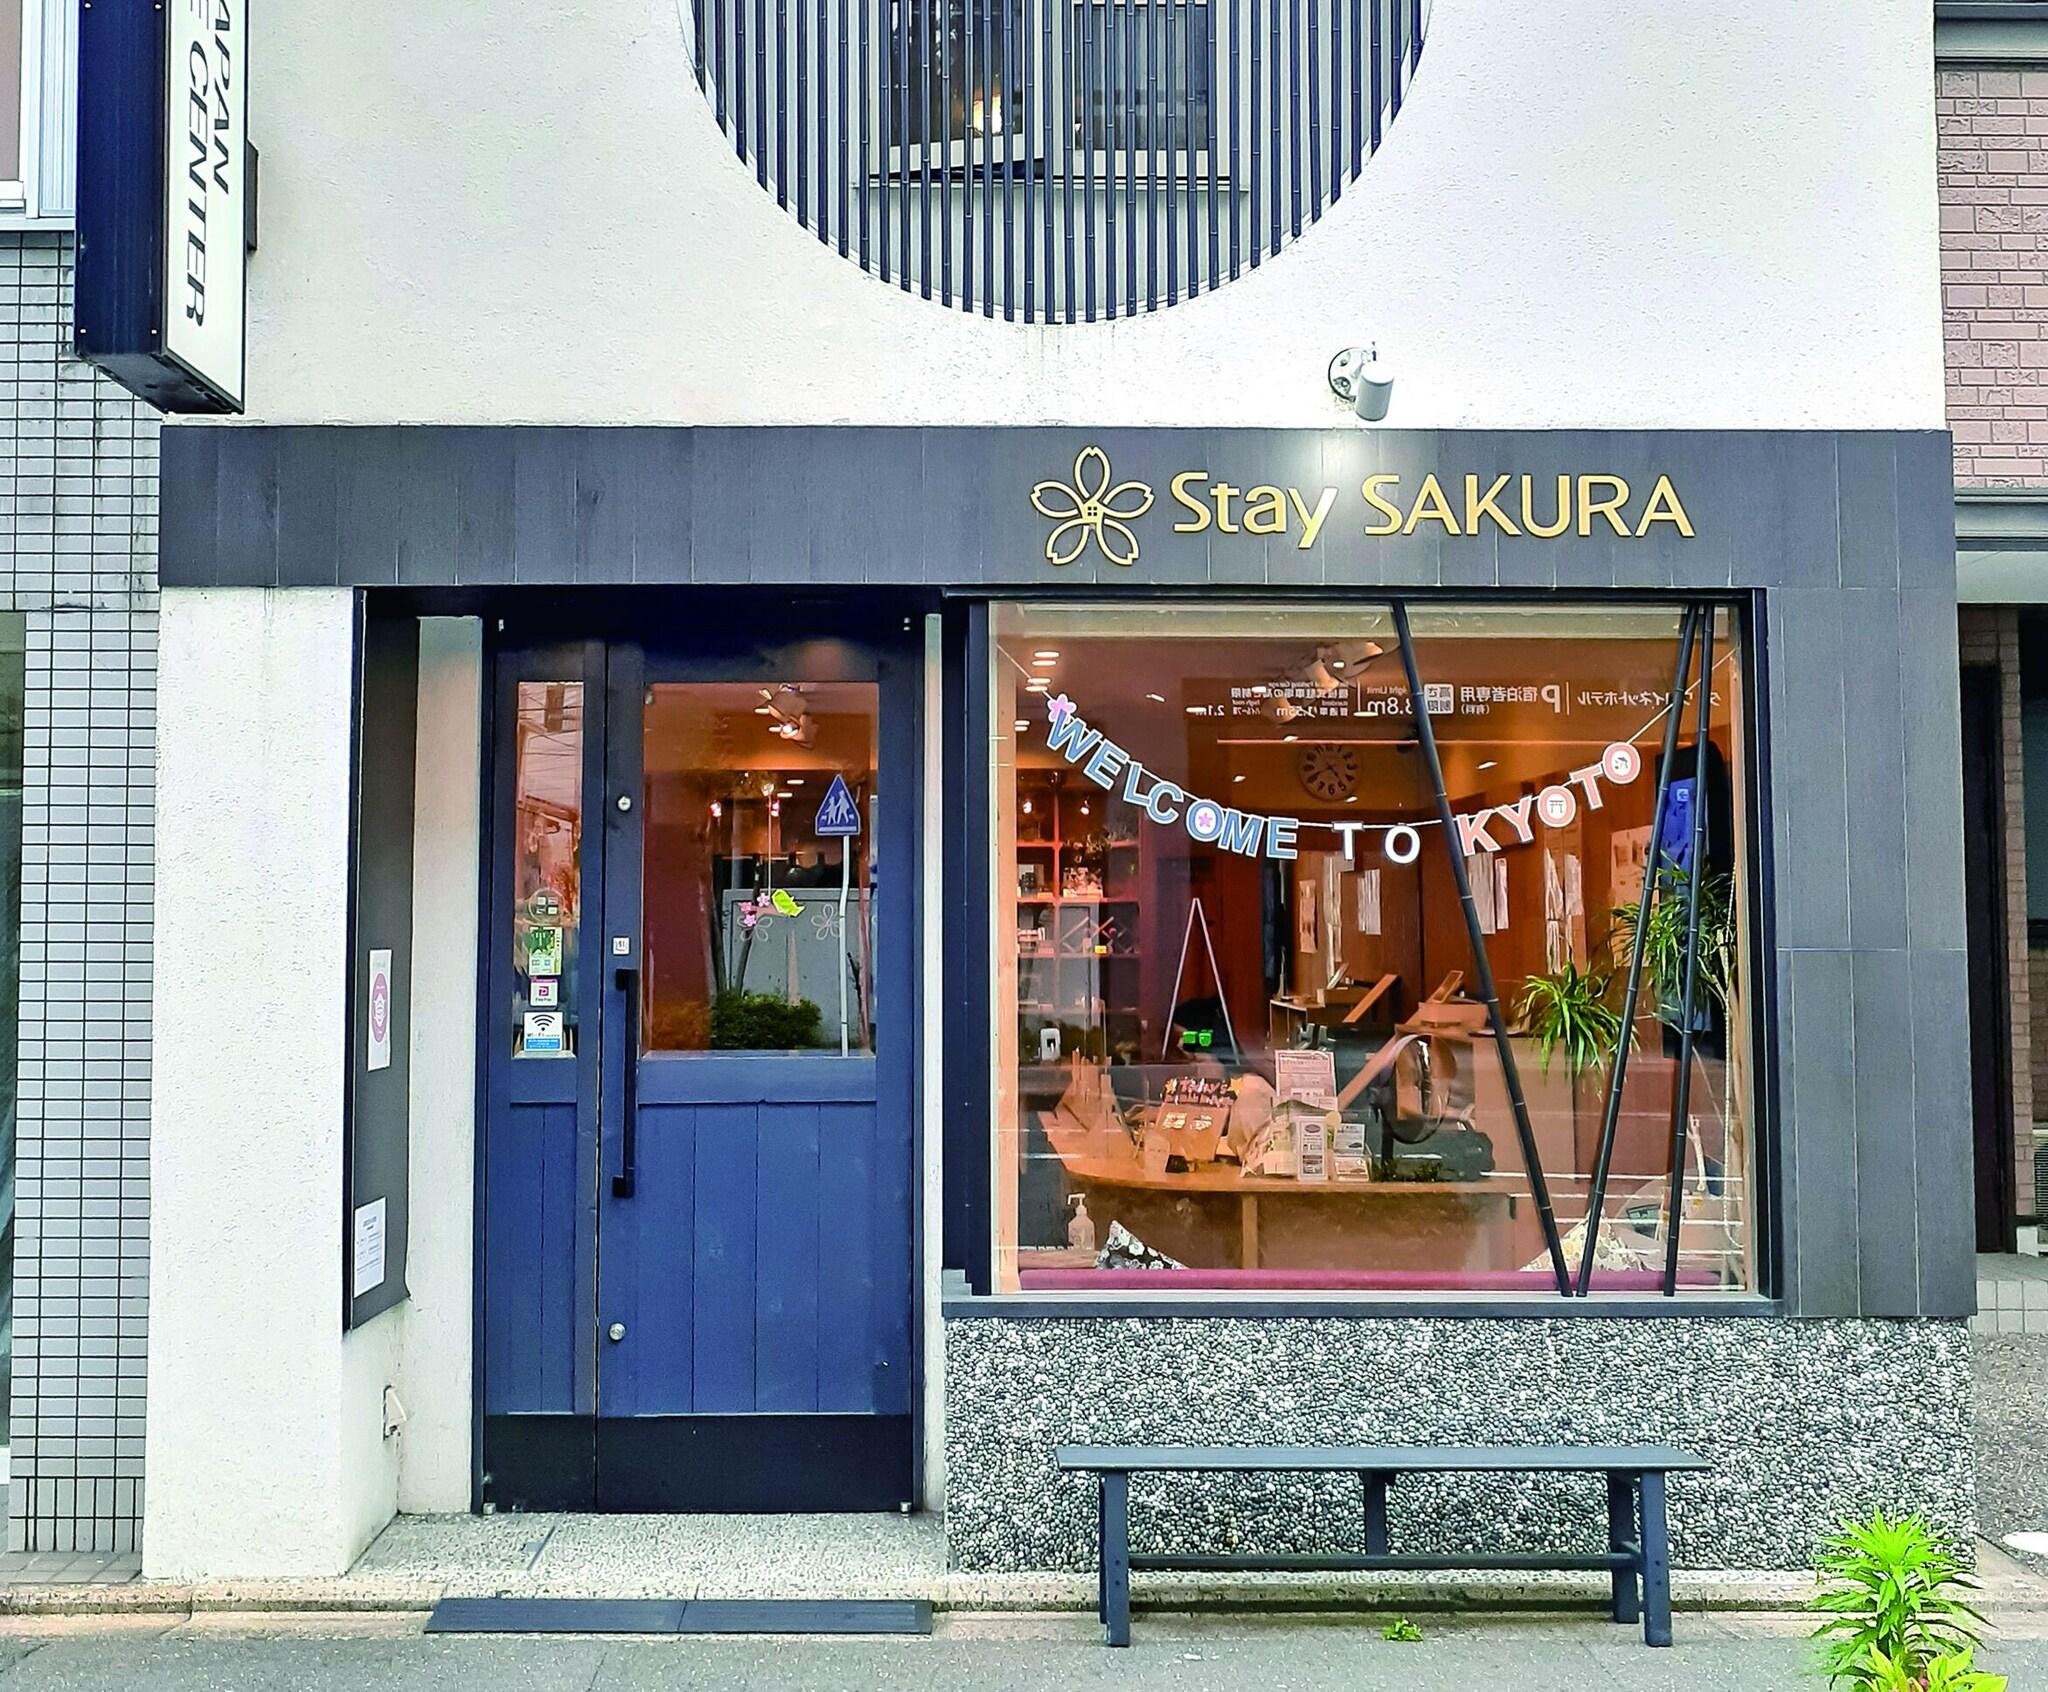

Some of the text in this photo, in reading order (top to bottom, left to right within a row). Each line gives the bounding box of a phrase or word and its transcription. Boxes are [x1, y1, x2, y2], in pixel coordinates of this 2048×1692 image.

[186, 40, 209, 328] CENTER
[1171, 470, 1695, 549] Stay SAKURA
[1046, 708, 1641, 865] WELCOME TO KYOTO
